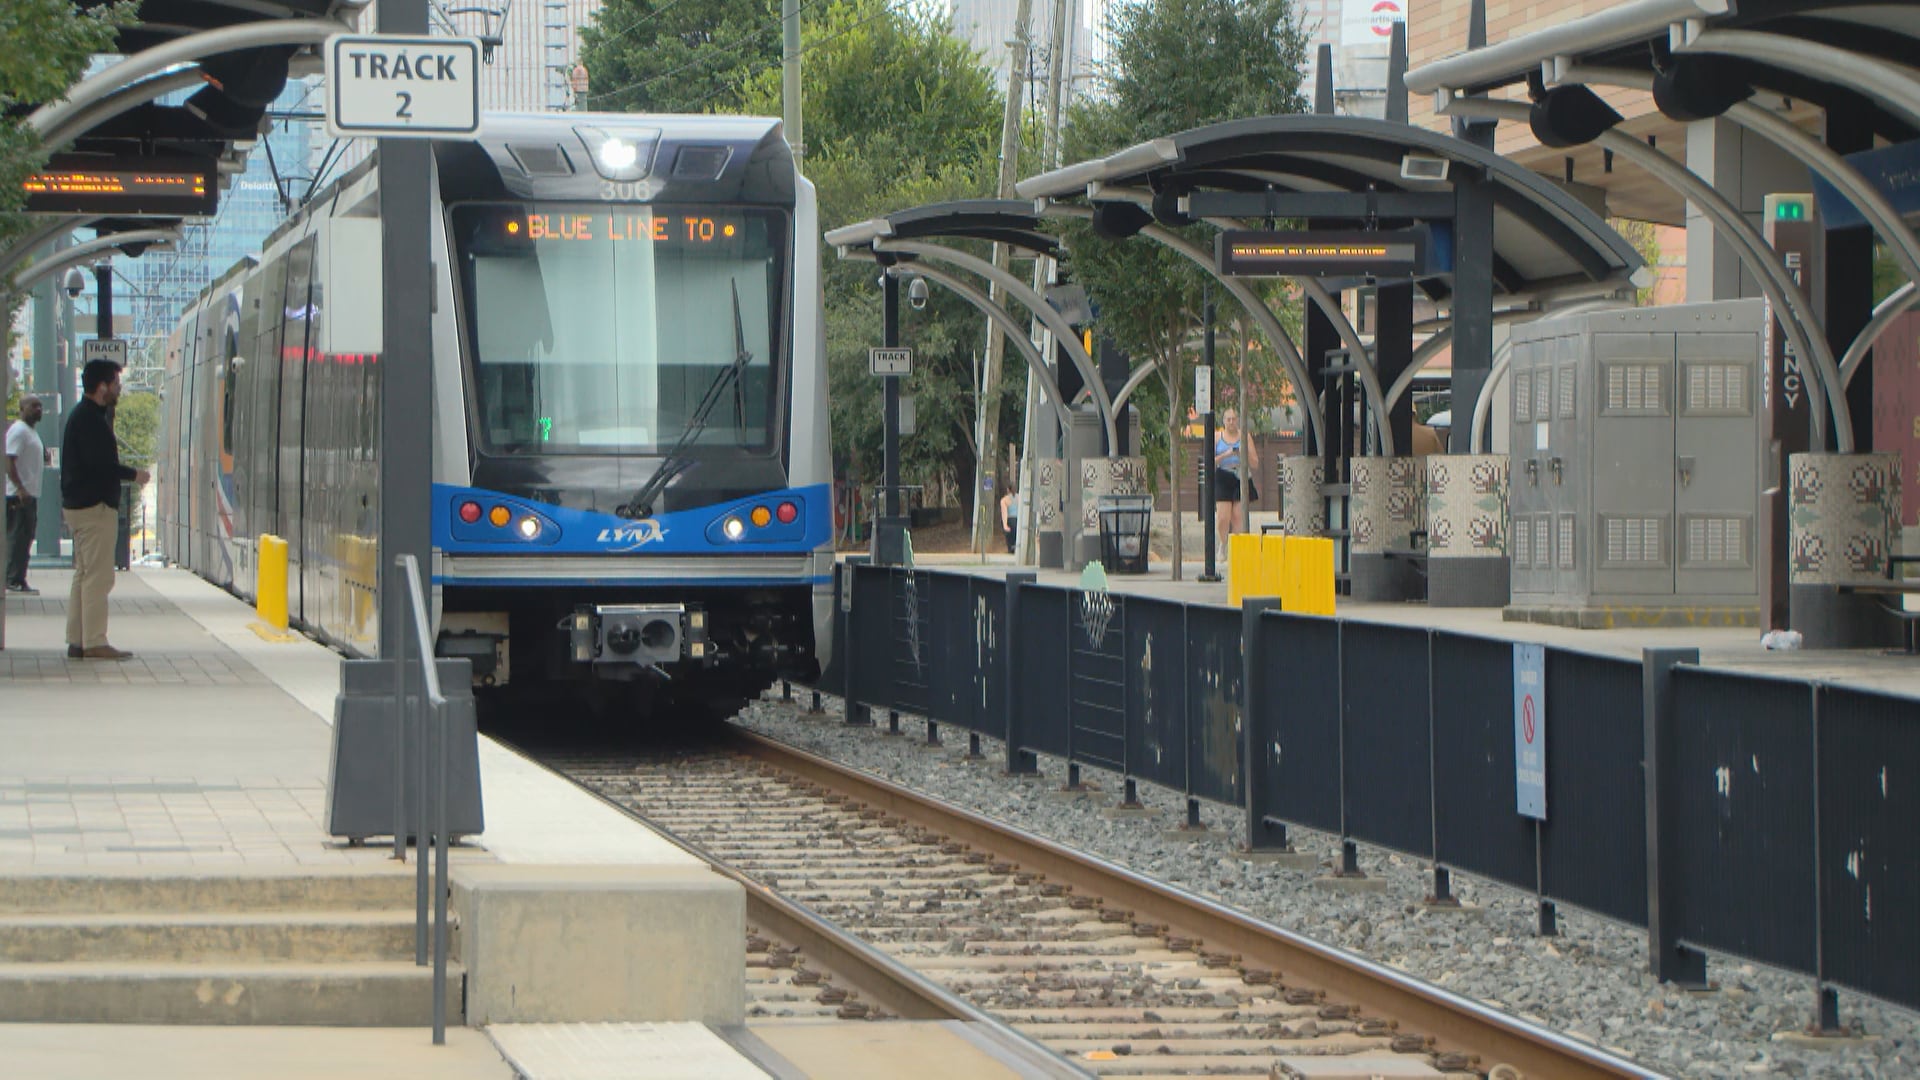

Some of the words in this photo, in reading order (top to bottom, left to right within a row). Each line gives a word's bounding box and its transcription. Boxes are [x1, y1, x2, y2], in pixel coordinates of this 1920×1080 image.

[349, 52, 457, 81] TRACK
[396, 91, 412, 118] 2
[600, 181, 651, 200] 306
[528, 215, 593, 240] BLUE
[608, 216, 669, 241] LINE
[685, 217, 715, 241] TO
[1784, 252, 1801, 409] EENCY
[89, 343, 121, 352] TRACK
[878, 352, 906, 360] TRACK
[596, 528, 671, 542] LYNX
